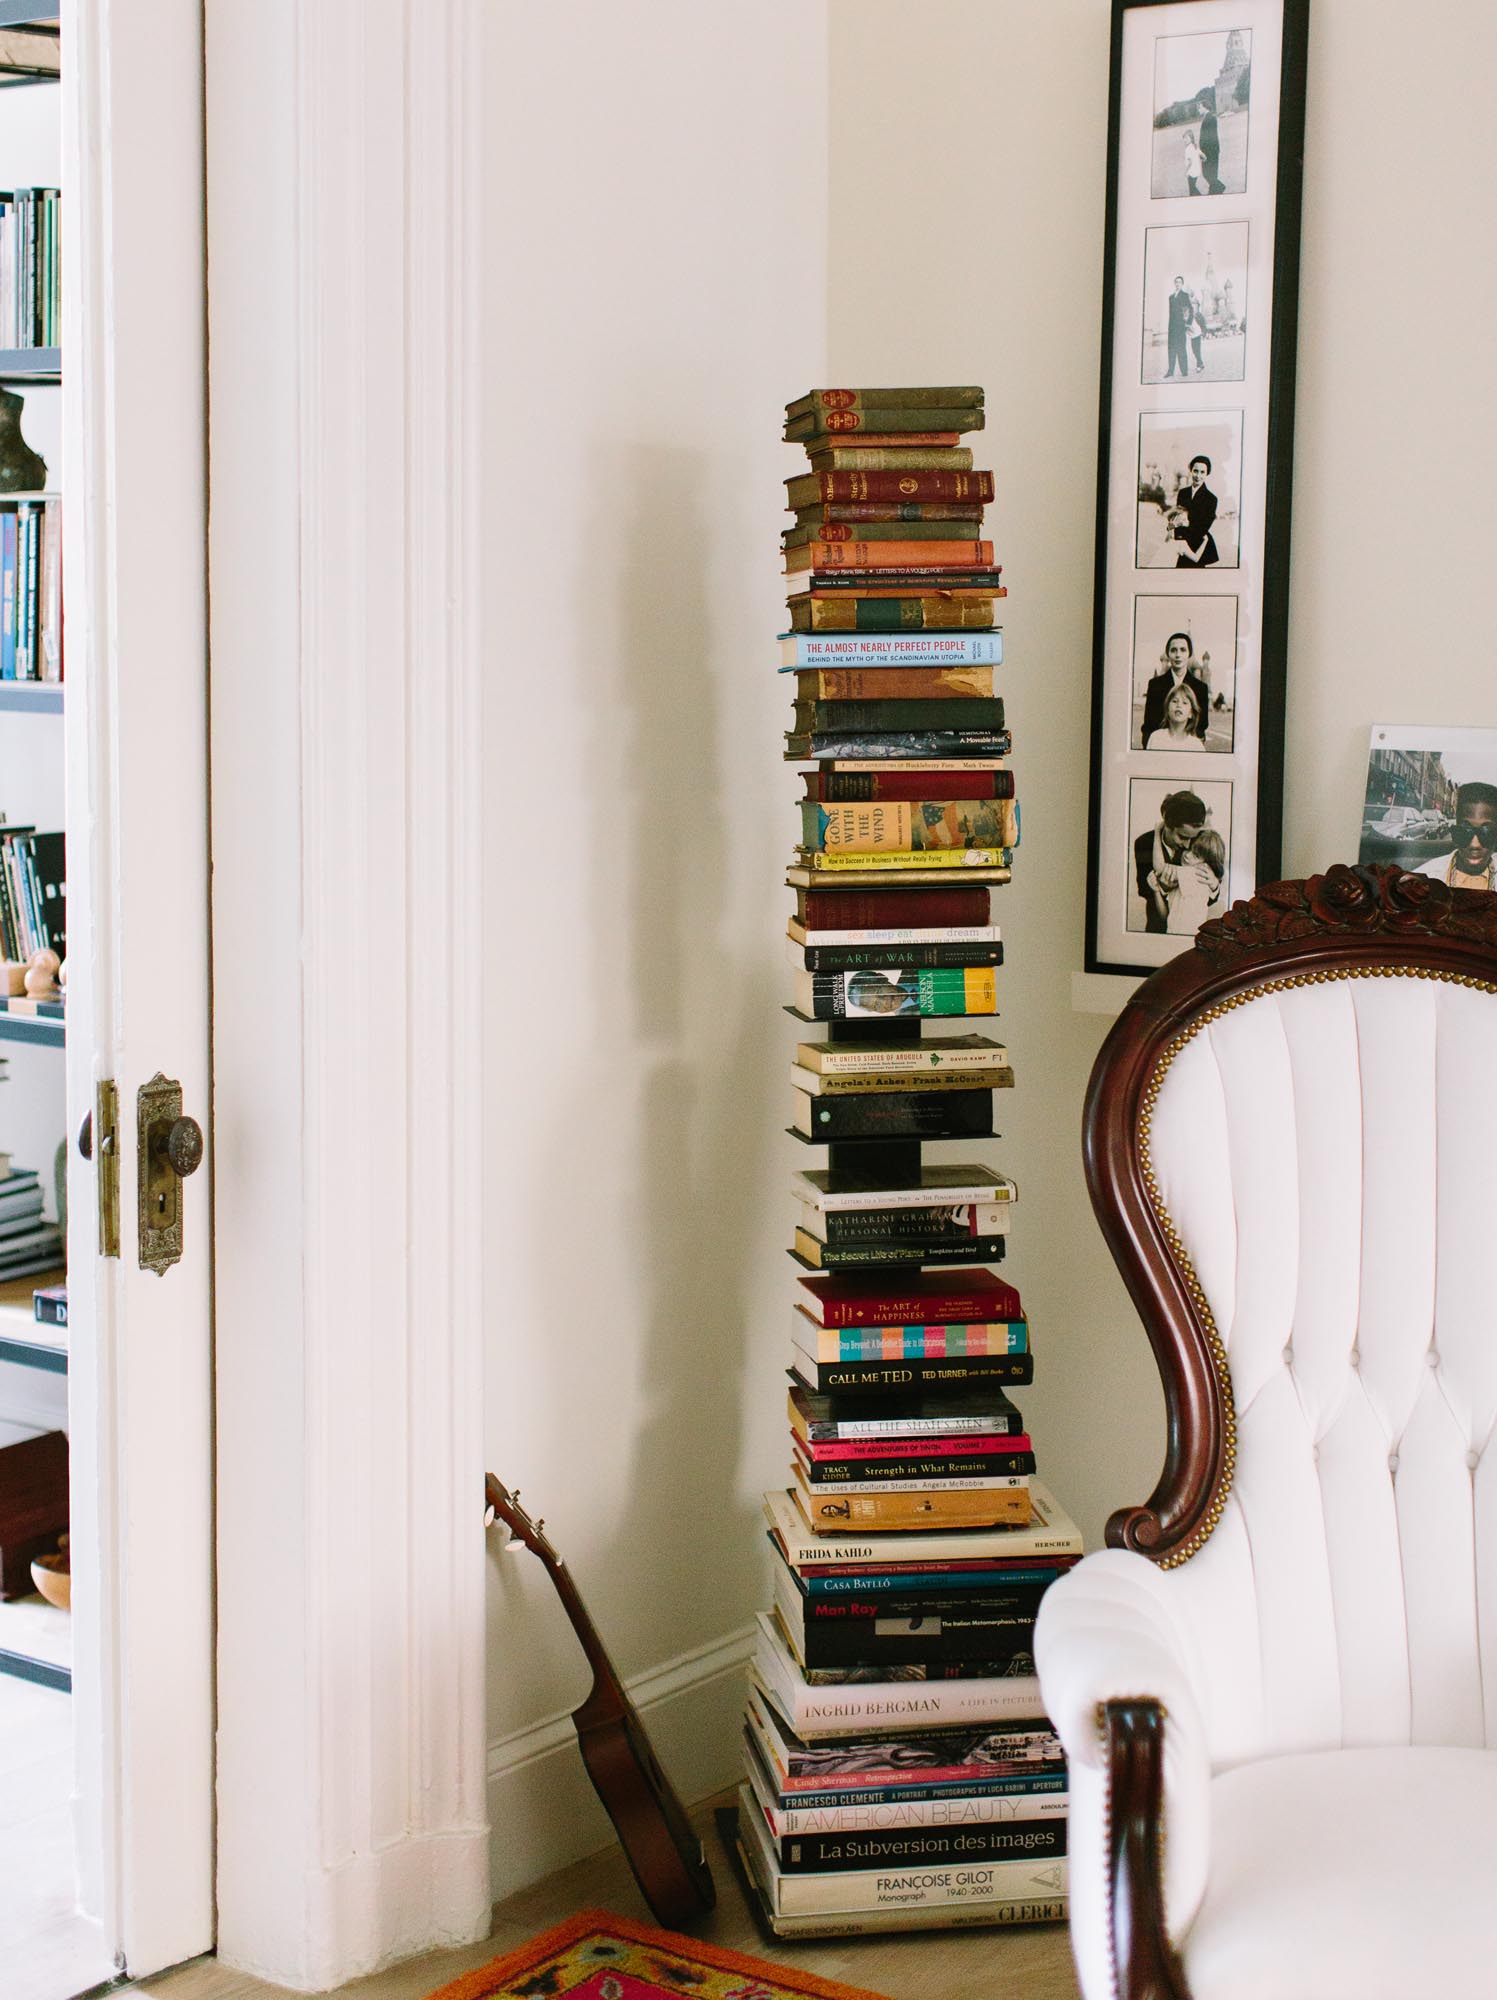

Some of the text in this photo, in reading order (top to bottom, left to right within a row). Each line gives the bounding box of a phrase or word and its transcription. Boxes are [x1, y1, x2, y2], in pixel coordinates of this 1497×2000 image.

[807, 641, 966, 653] THE ALMOST NEARLY PERFECT PEOPLE
[829, 809, 841, 845] GONE
[844, 809, 855, 843] WITH
[858, 814, 869, 838] THE
[873, 807, 884, 844] WIND
[867, 930, 894, 939] sleep
[897, 930, 913, 938] eat
[946, 928, 979, 937] dream
[846, 953, 871, 964] ART
[874, 955, 883, 966] of
[886, 952, 914, 962] WAR
[926, 972, 935, 1012] MANDELA
[863, 1054, 884, 1062] STATES
[826, 1079, 871, 1088] Angela's
[912, 1076, 941, 1084] Frank
[944, 1075, 985, 1083] McCourt
[828, 1212, 953, 1225] KATHARINE GRAHAM
[837, 1225, 945, 1236] PERSONAL HISTORY
[823, 1252, 840, 1261] The
[840, 1252, 869, 1261] Secret
[870, 1250, 887, 1259] Life
[887, 1250, 898, 1259] of
[898, 1249, 925, 1258] Plants
[892, 1302, 911, 1311] ART
[913, 1302, 921, 1311] of
[873, 1312, 925, 1321] HAPPINESS
[828, 1374, 859, 1385] CALL
[861, 1372, 880, 1383] ME
[880, 1369, 913, 1383] TED
[921, 1370, 936, 1379] TED
[937, 1369, 968, 1379] TURNER
[851, 1419, 982, 1433] ALL THE SHAH'S MEN
[864, 1463, 986, 1476] Strength in What Remains
[891, 1482, 917, 1490] Studies
[922, 1481, 947, 1489] Angela
[799, 1549, 831, 1560] FRIDA
[835, 1547, 872, 1558] KAHLO
[815, 1604, 846, 1617] Man
[850, 1602, 879, 1617] Ray
[972, 1618, 1017, 1627] Metamorphosis,
[805, 1703, 861, 1718] INGRID
[866, 1697, 942, 1715] BERGMAN
[967, 1698, 987, 1706] LIFE
[990, 1697, 1000, 1705] IN
[1002, 1695, 1041, 1705] PICTURE
[983, 1744, 1027, 1752] Georges
[794, 1772, 913, 1787] Cindy Sherman Retrospective
[785, 1795, 837, 1809] FRANCESCO
[839, 1792, 885, 1805] CLEMENTE
[897, 1791, 927, 1800] PORTRAIT
[932, 1788, 977, 1797] PHOTOGRAPHS
[987, 1785, 1004, 1793] LUCA
[1032, 1782, 1063, 1791] APERTURE
[803, 1805, 923, 1832] AMERICAN
[932, 1798, 1022, 1824] BEAUTY
[820, 1832, 1055, 1859] La Subversion des images
[877, 1870, 994, 1891] FRANÇOISE GILOT
[878, 1890, 927, 1902] Monograph
[998, 1903, 1063, 1921] CLERICI
